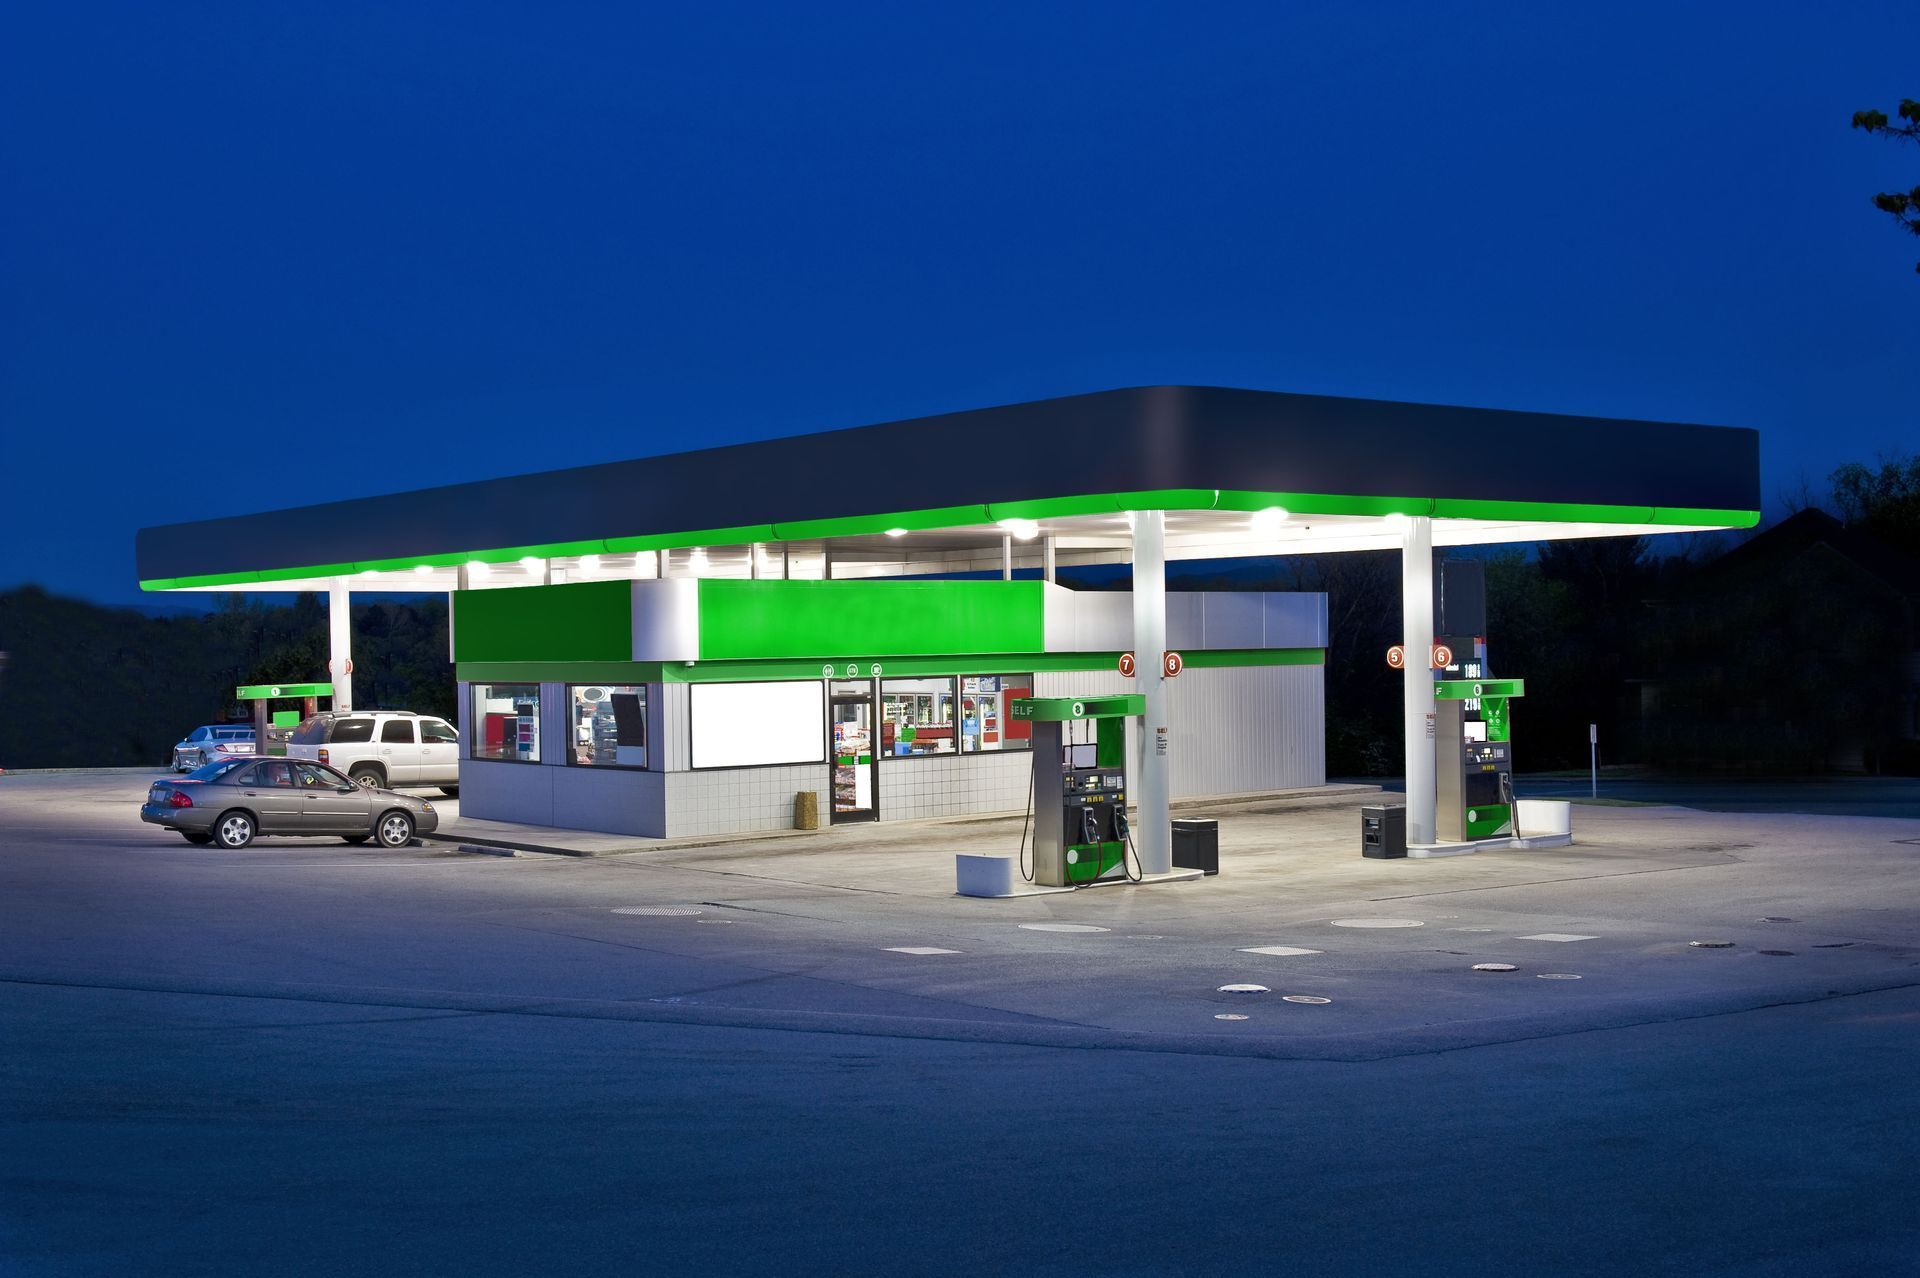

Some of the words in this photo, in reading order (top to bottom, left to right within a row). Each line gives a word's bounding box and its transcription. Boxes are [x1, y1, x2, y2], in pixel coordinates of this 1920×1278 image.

[1391, 652, 1398, 662] 5
[1438, 652, 1445, 662] 6
[1123, 659, 1129, 670] 7
[1169, 659, 1176, 670] 8
